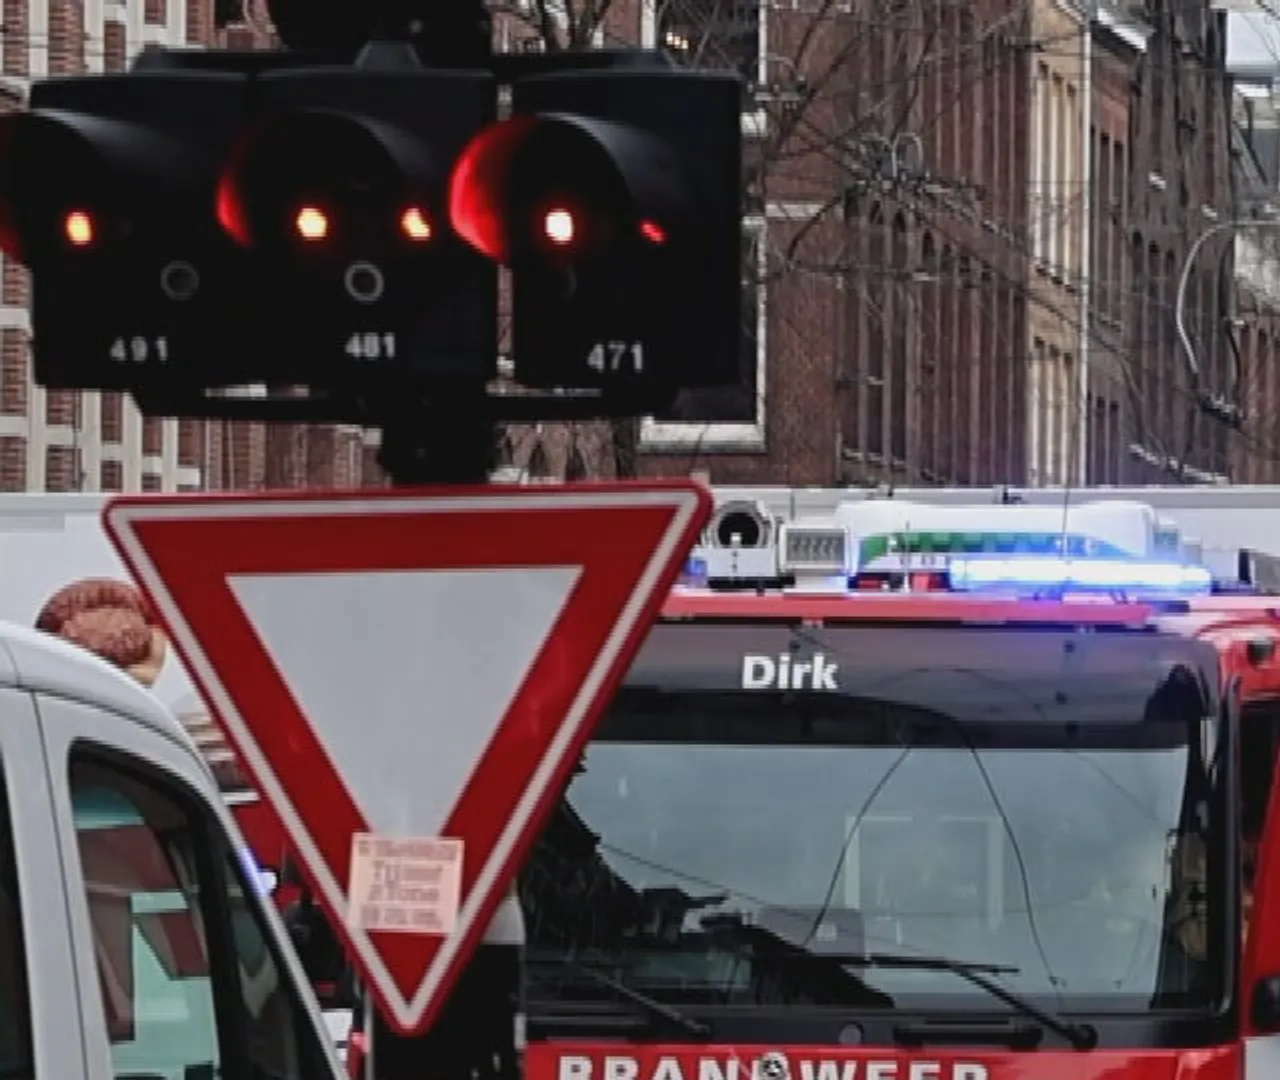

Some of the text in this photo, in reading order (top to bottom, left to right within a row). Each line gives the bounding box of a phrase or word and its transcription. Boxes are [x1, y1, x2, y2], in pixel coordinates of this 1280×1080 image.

[345, 332, 396, 359] 481
[587, 341, 643, 374] 471
[742, 655, 838, 690] Dirk
